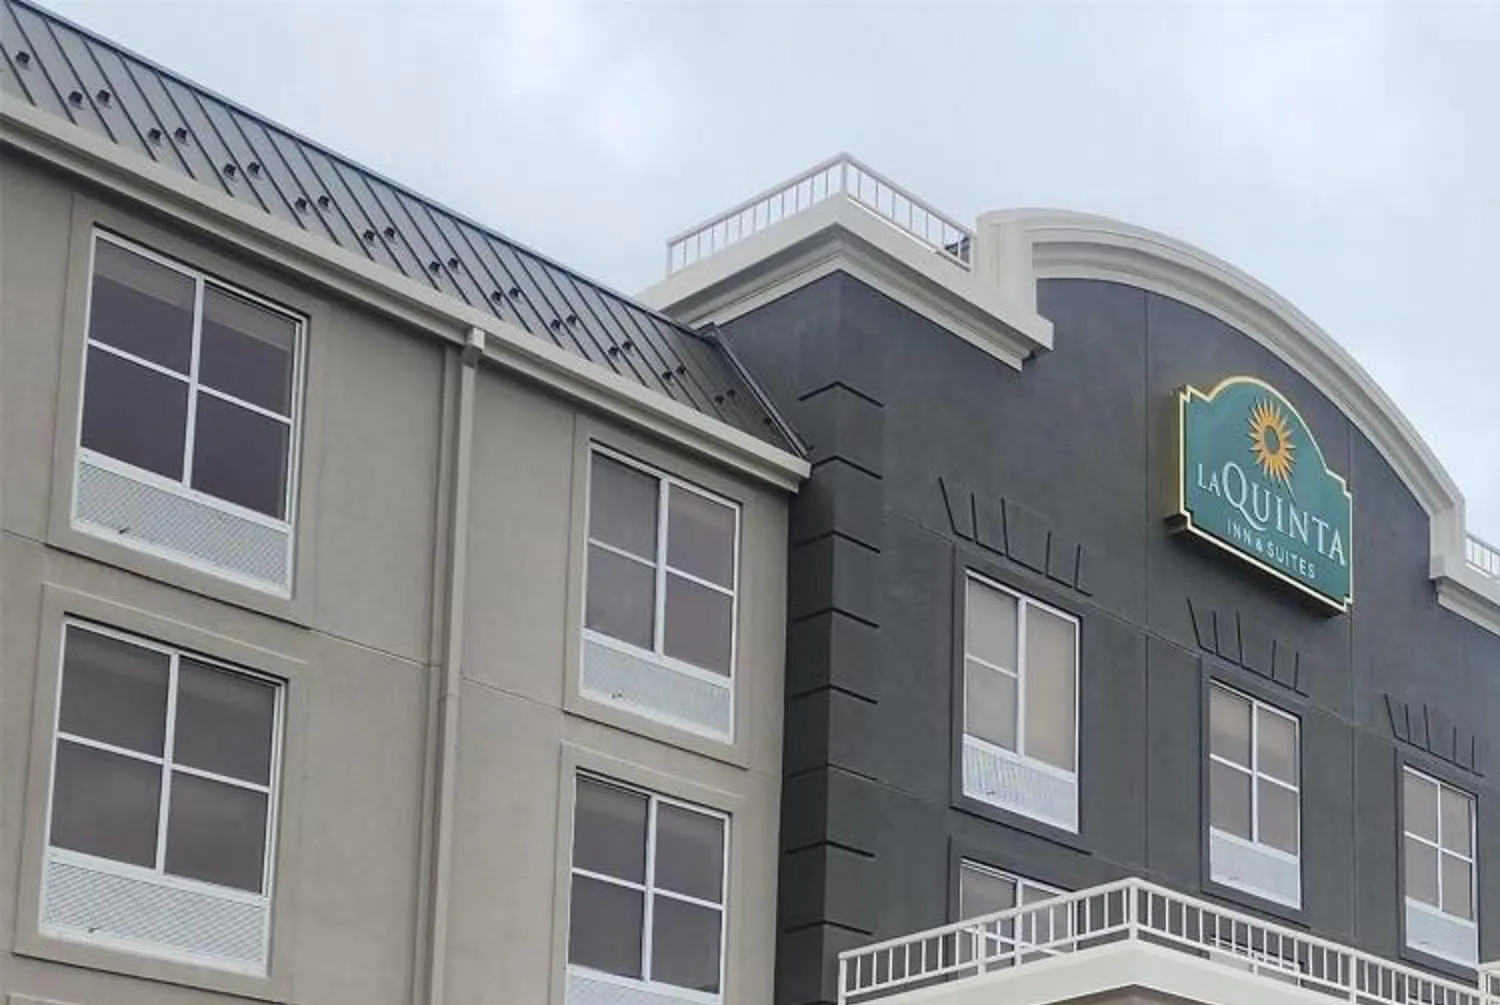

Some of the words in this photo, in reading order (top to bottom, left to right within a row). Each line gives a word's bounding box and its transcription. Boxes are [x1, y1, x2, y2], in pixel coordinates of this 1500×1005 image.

[1227, 518, 1251, 545] INN
[1255, 537, 1264, 551] &
[1267, 541, 1316, 579] SUITES
